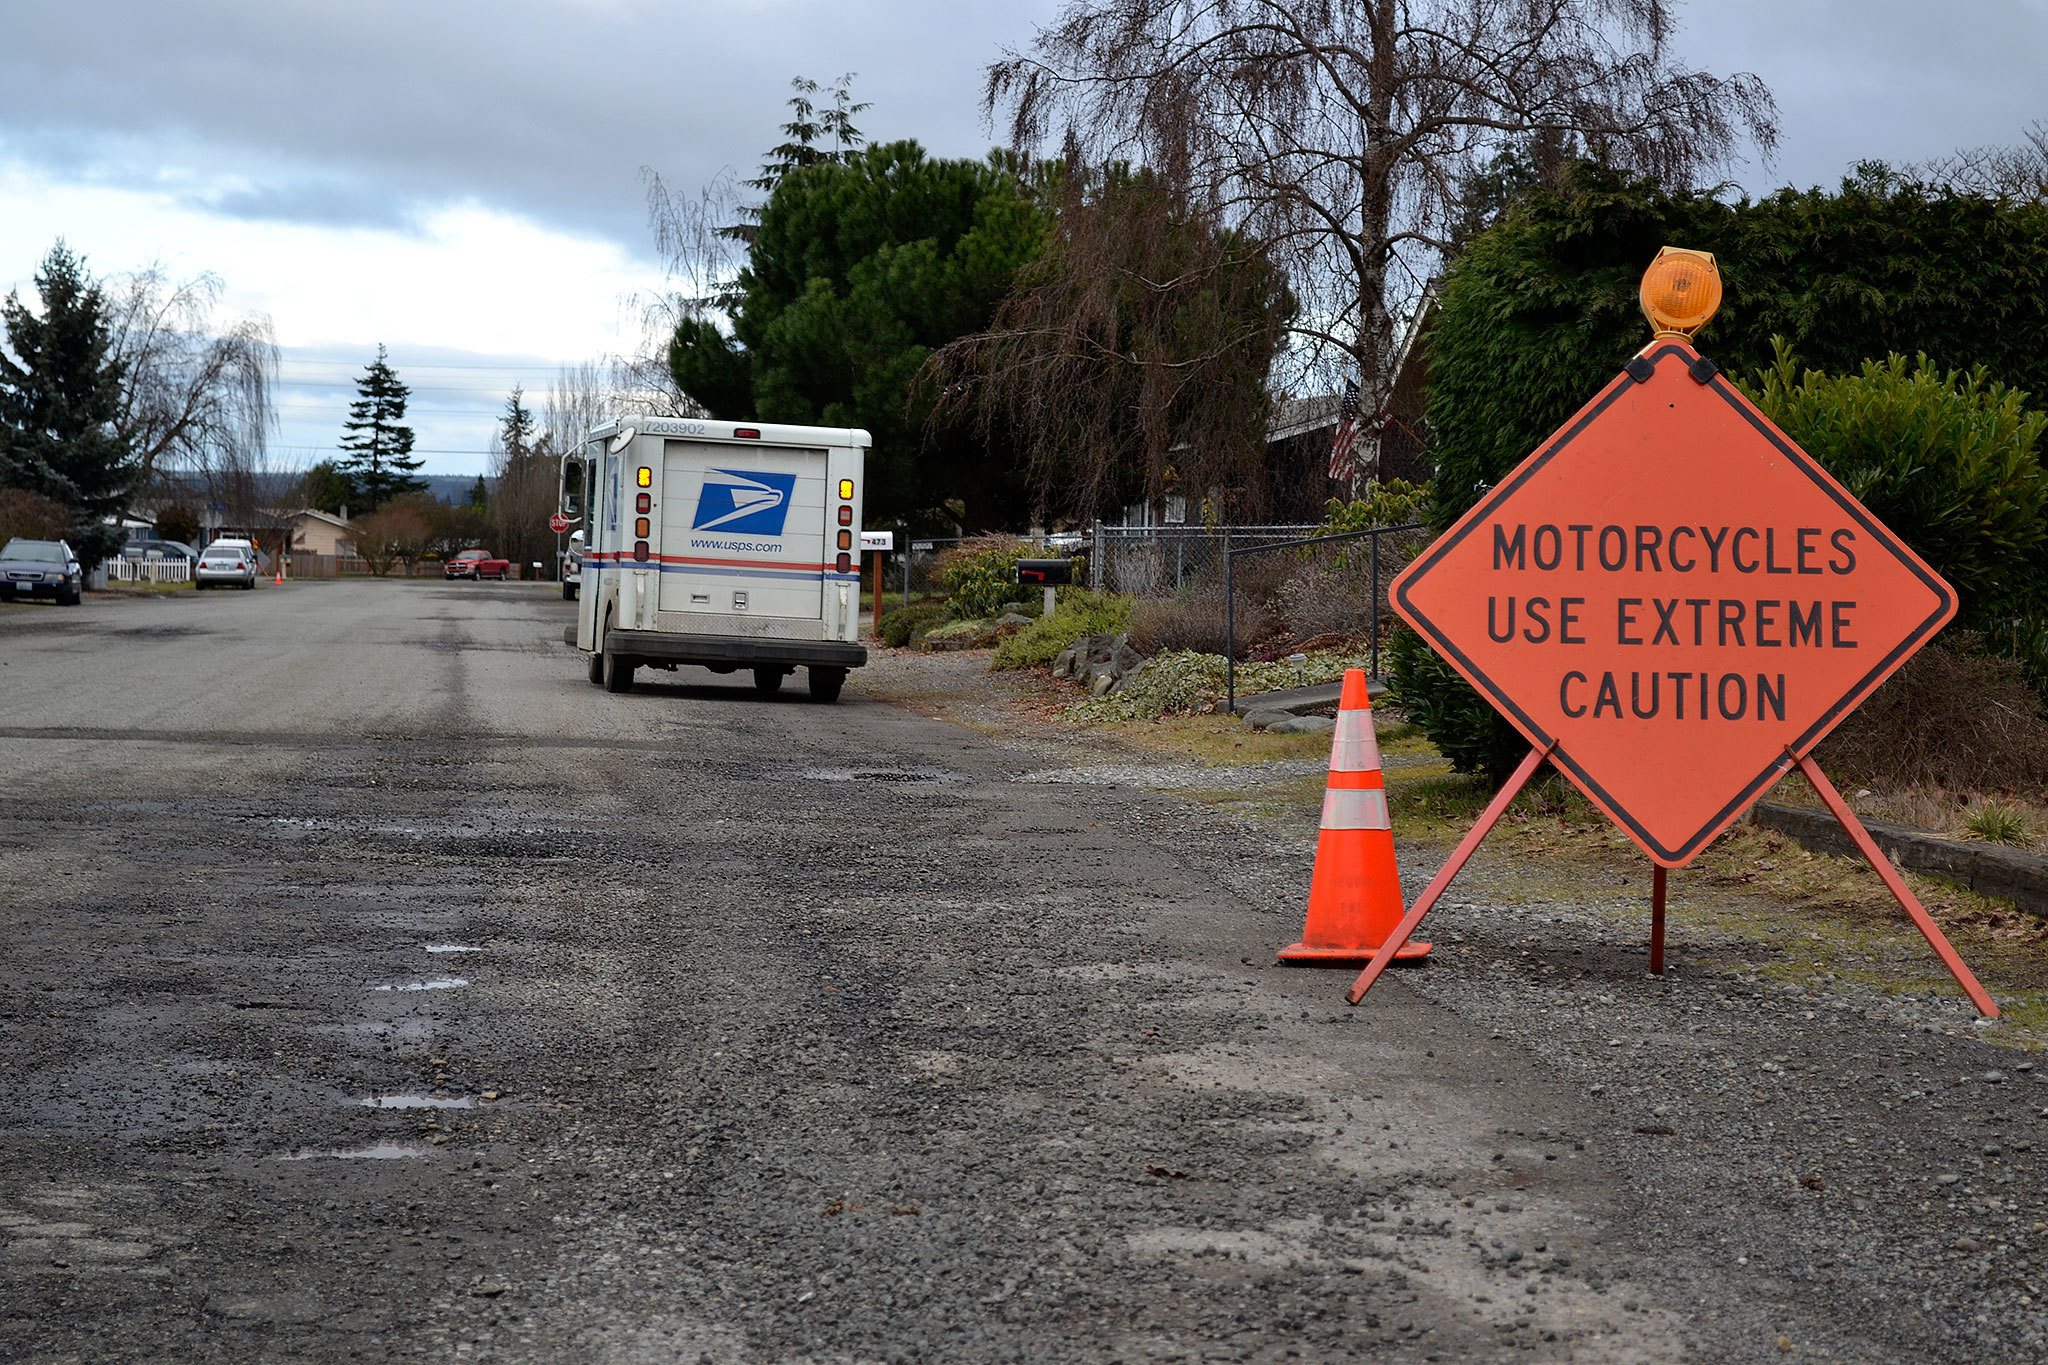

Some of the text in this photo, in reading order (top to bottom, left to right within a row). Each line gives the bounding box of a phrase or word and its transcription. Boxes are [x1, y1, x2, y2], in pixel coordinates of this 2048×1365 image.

[644, 420, 705, 435] 7203902
[691, 539, 782, 553] www.usps.com
[1493, 524, 1857, 575] MOTORCYCLES
[1488, 596, 1858, 649] USE EXTREME
[1559, 670, 1786, 722] CAUTION
